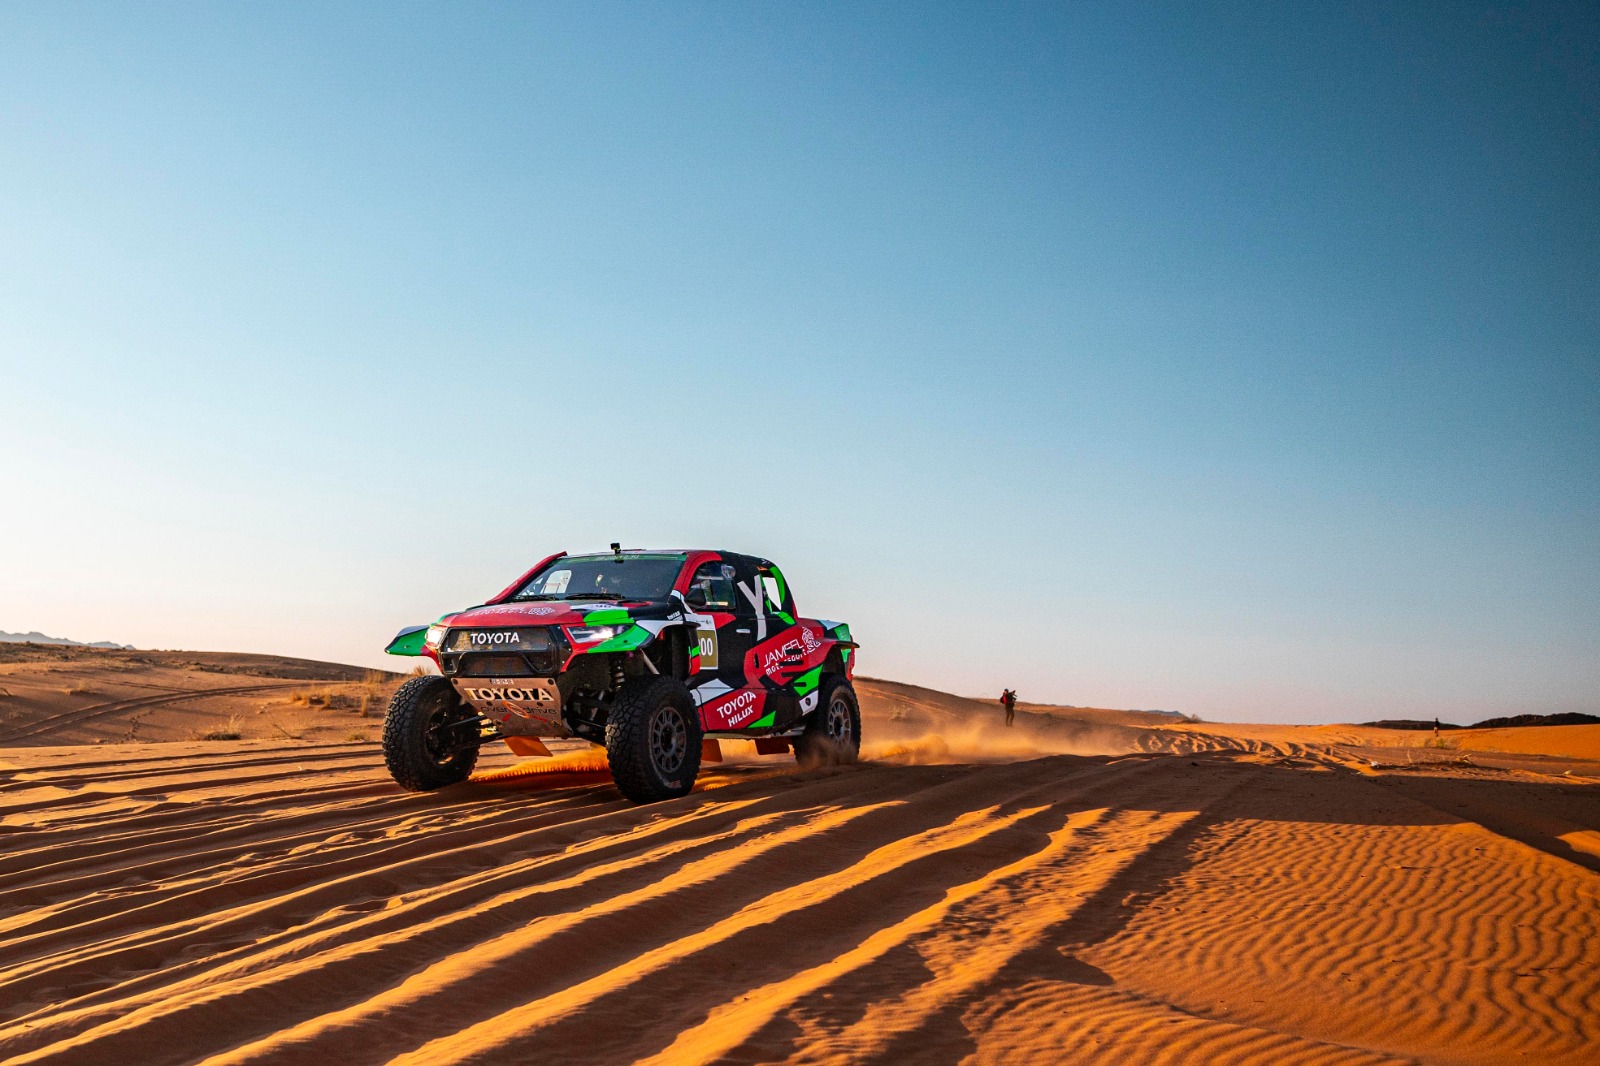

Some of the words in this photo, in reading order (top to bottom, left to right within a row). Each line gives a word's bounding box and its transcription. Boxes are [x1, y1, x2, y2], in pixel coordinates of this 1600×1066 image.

[470, 631, 520, 645] TOYOTA
[698, 637, 714, 656] 00
[463, 687, 555, 702] TOYOTA
[480, 705, 509, 713] over
[525, 706, 558, 715] drive
[716, 690, 757, 719] TOYOTA
[727, 705, 754, 727] HILUX
